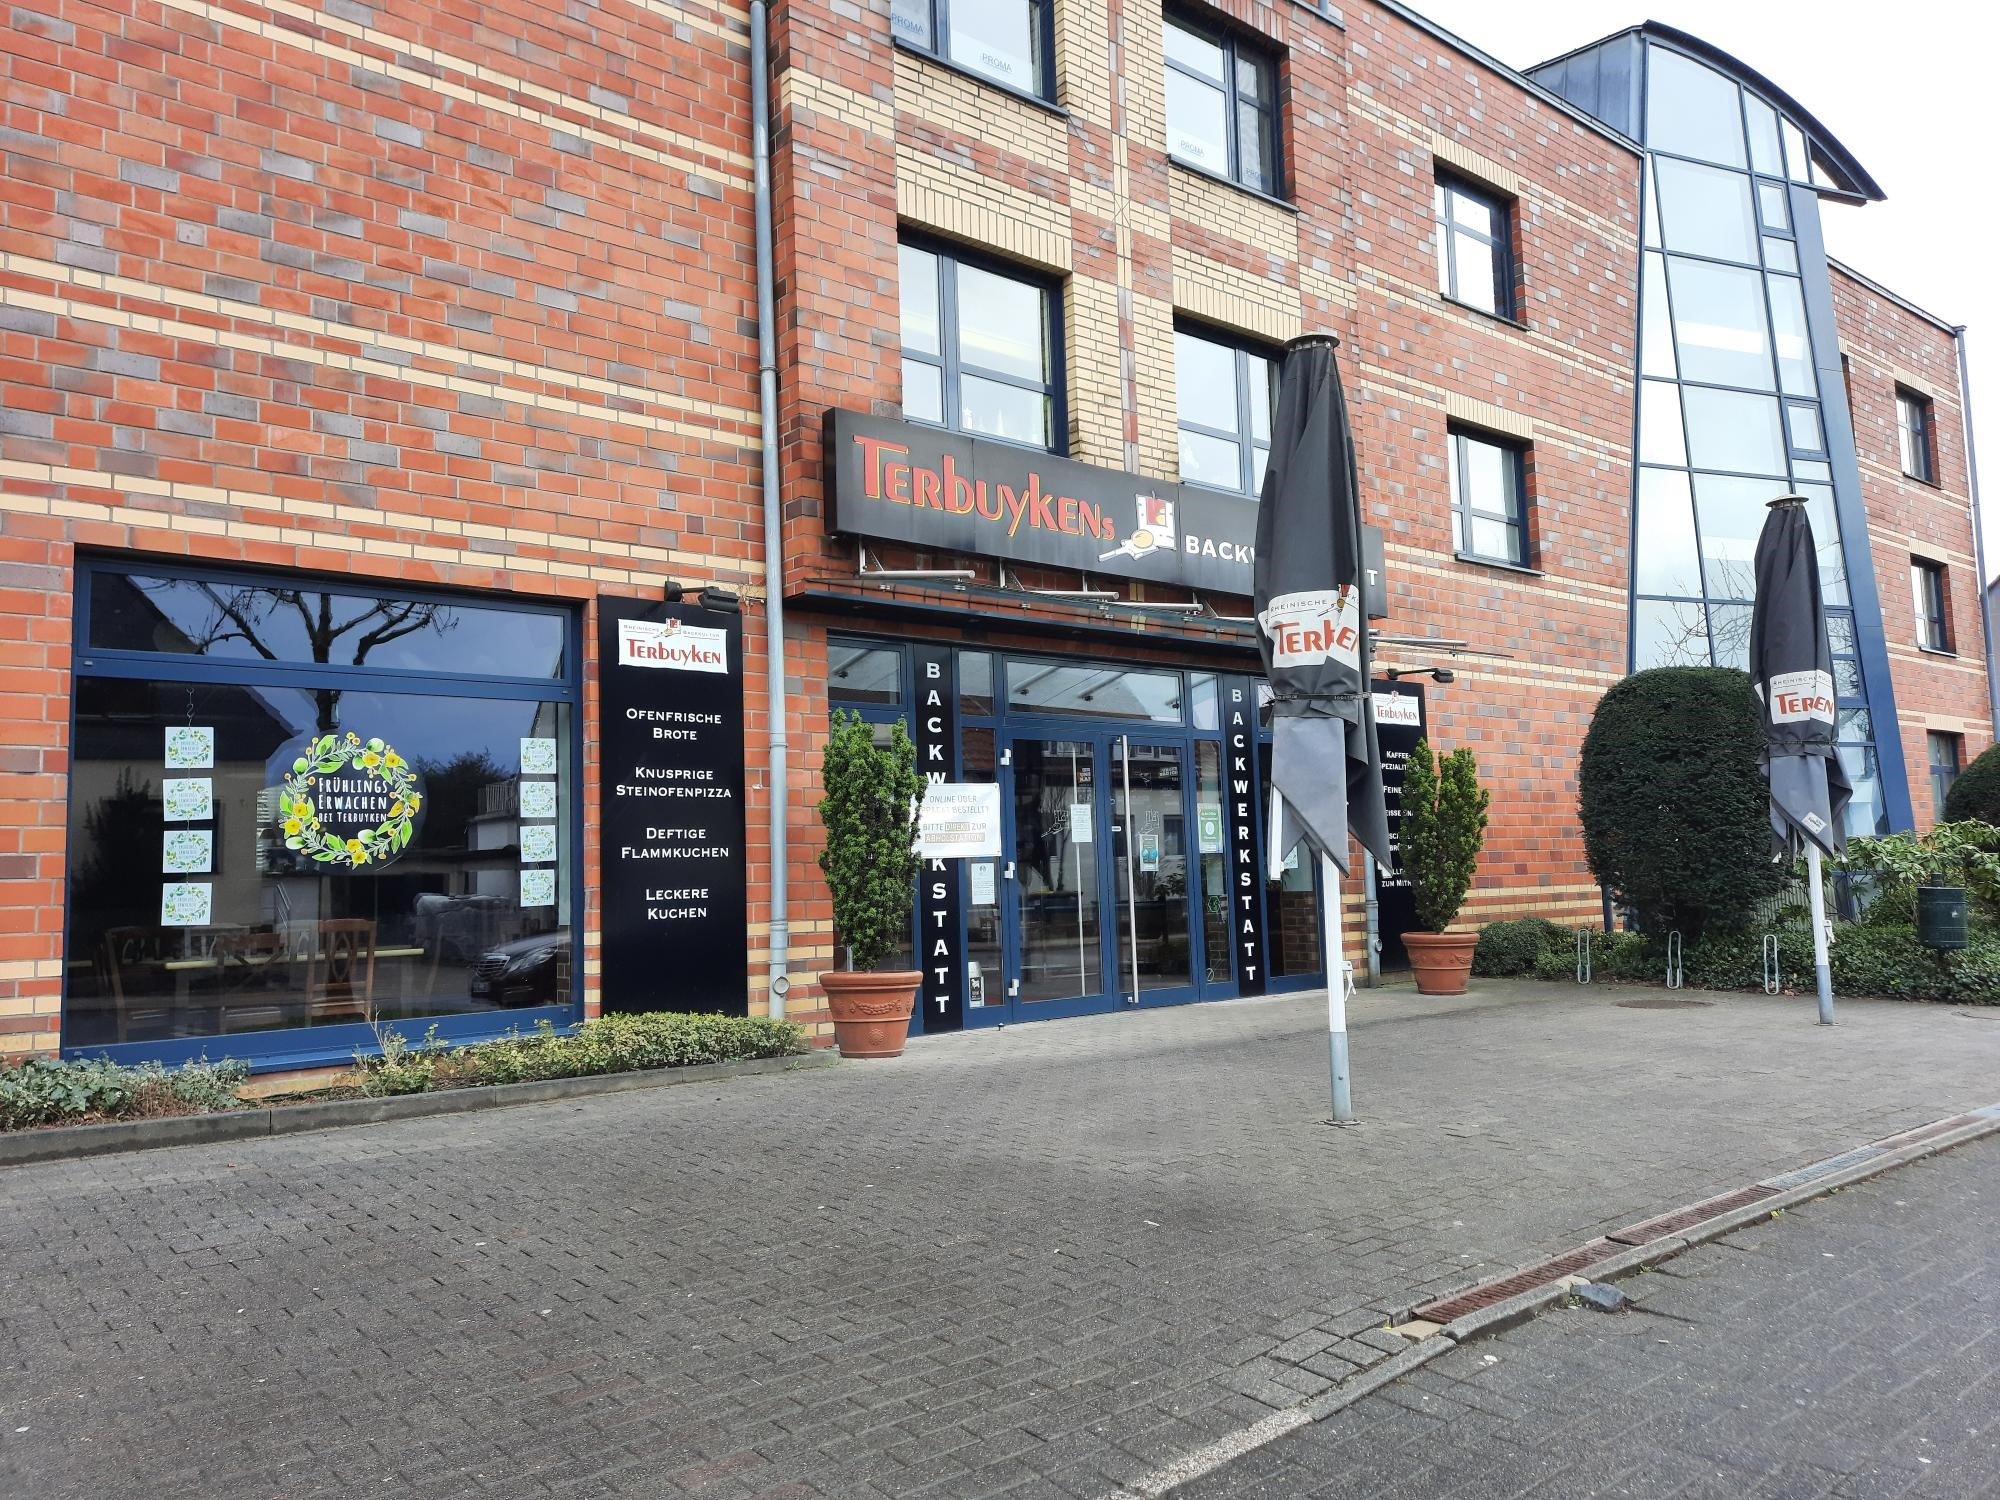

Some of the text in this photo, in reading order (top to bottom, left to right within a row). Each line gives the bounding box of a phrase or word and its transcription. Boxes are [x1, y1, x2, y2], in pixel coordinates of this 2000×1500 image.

[982, 52, 1013, 73] PROMA
[1270, 599, 1328, 613] RHEINISCHE
[626, 708, 722, 724] OFENFRISCHE
[653, 727, 697, 741] BROTE
[635, 766, 714, 780] KNUSPRIGE
[318, 777, 388, 793] FRÜHLINGS
[616, 784, 732, 798] STEINOFENPIZZA
[318, 794, 387, 810] ERWACHEN
[929, 795, 956, 804] ONLINE
[318, 811, 387, 823] BEI TERBUYKEN
[646, 827, 706, 840] DEFTIGE
[923, 823, 945, 831] BITTE
[971, 823, 987, 831] ZUR
[1231, 688, 1255, 981] BACKWERKSTATT
[621, 847, 729, 859] FLAMMKUCHEN
[645, 887, 709, 901] LECKERE
[647, 907, 707, 920] KUCHEN
